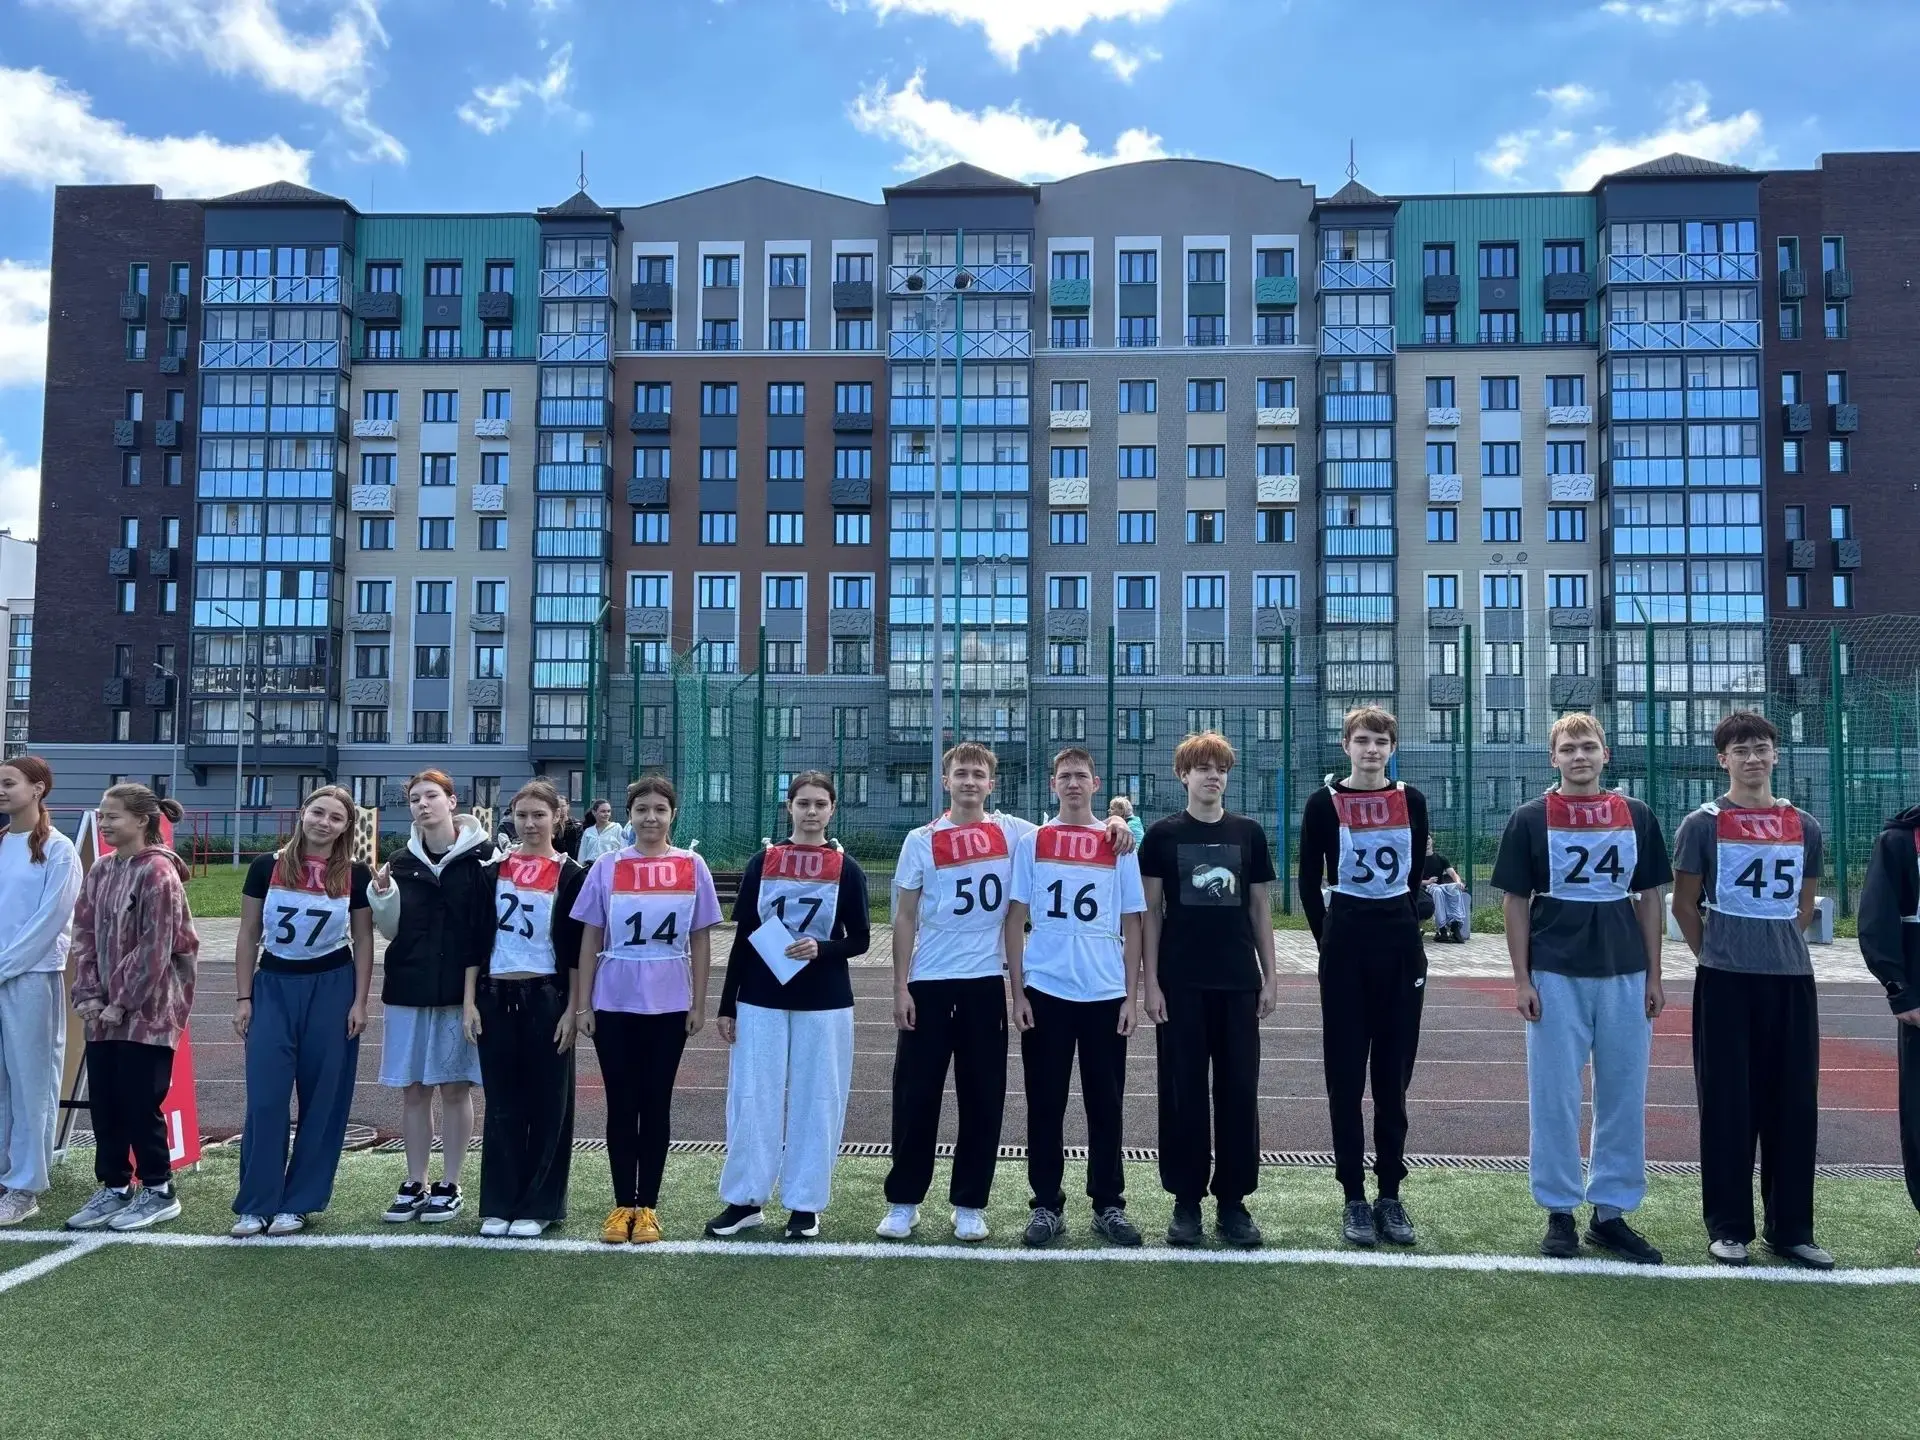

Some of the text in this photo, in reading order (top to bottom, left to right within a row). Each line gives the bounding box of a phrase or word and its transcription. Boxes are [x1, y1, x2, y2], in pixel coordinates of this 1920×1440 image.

[780, 849, 823, 876] ГТО
[950, 828, 990, 859] ГТО
[1055, 830, 1098, 859] ГТО
[633, 861, 677, 889] ГТО
[1352, 846, 1399, 884] 39
[1564, 845, 1625, 883] 24
[1735, 858, 1795, 899] 45
[953, 873, 1002, 915] 50
[1047, 880, 1098, 921] 16
[275, 905, 332, 946] 37
[498, 893, 534, 939] 25
[624, 911, 678, 945] 14
[771, 896, 823, 932] 17
